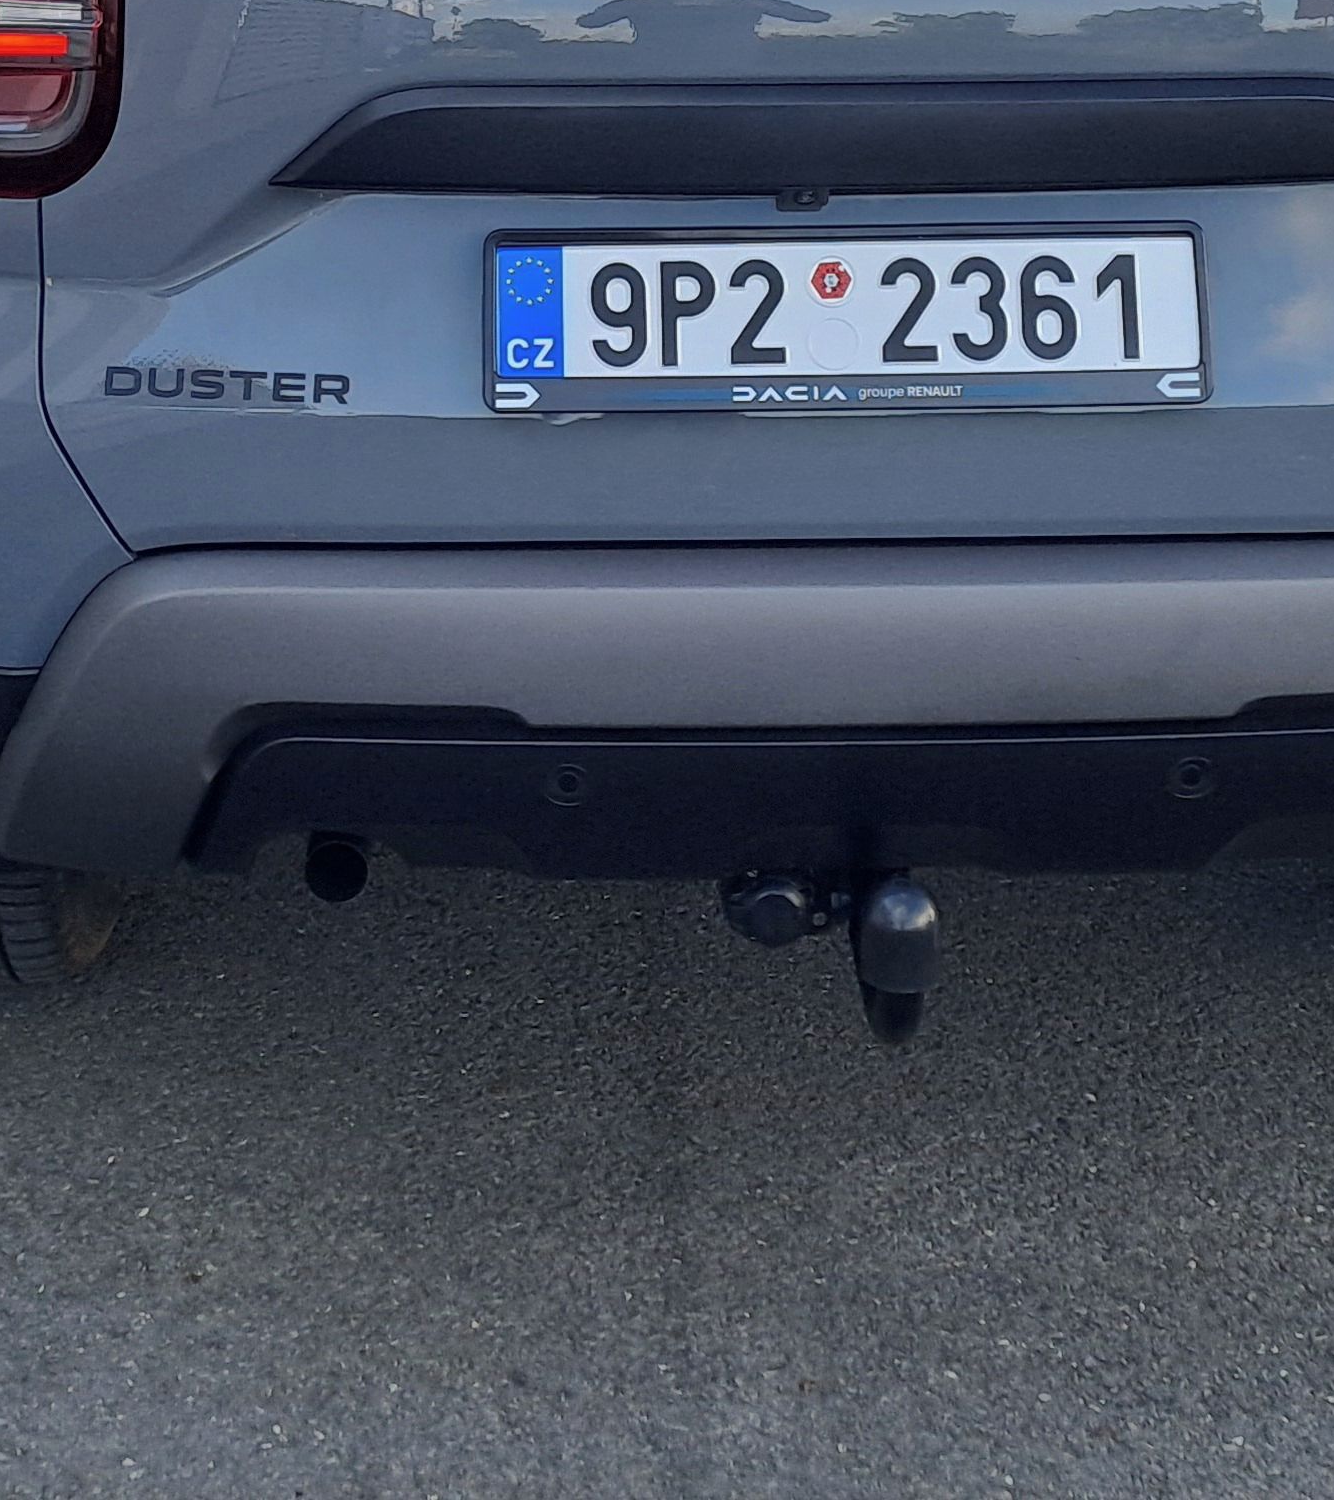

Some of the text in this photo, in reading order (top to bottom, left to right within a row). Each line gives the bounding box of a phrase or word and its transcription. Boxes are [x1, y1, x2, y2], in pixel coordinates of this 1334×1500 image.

[590, 253, 1140, 367] 9P2 2361
[506, 338, 555, 369] CZ
[104, 366, 350, 405] DUSTER
[732, 385, 964, 402] DACIA groupe RENAULT
